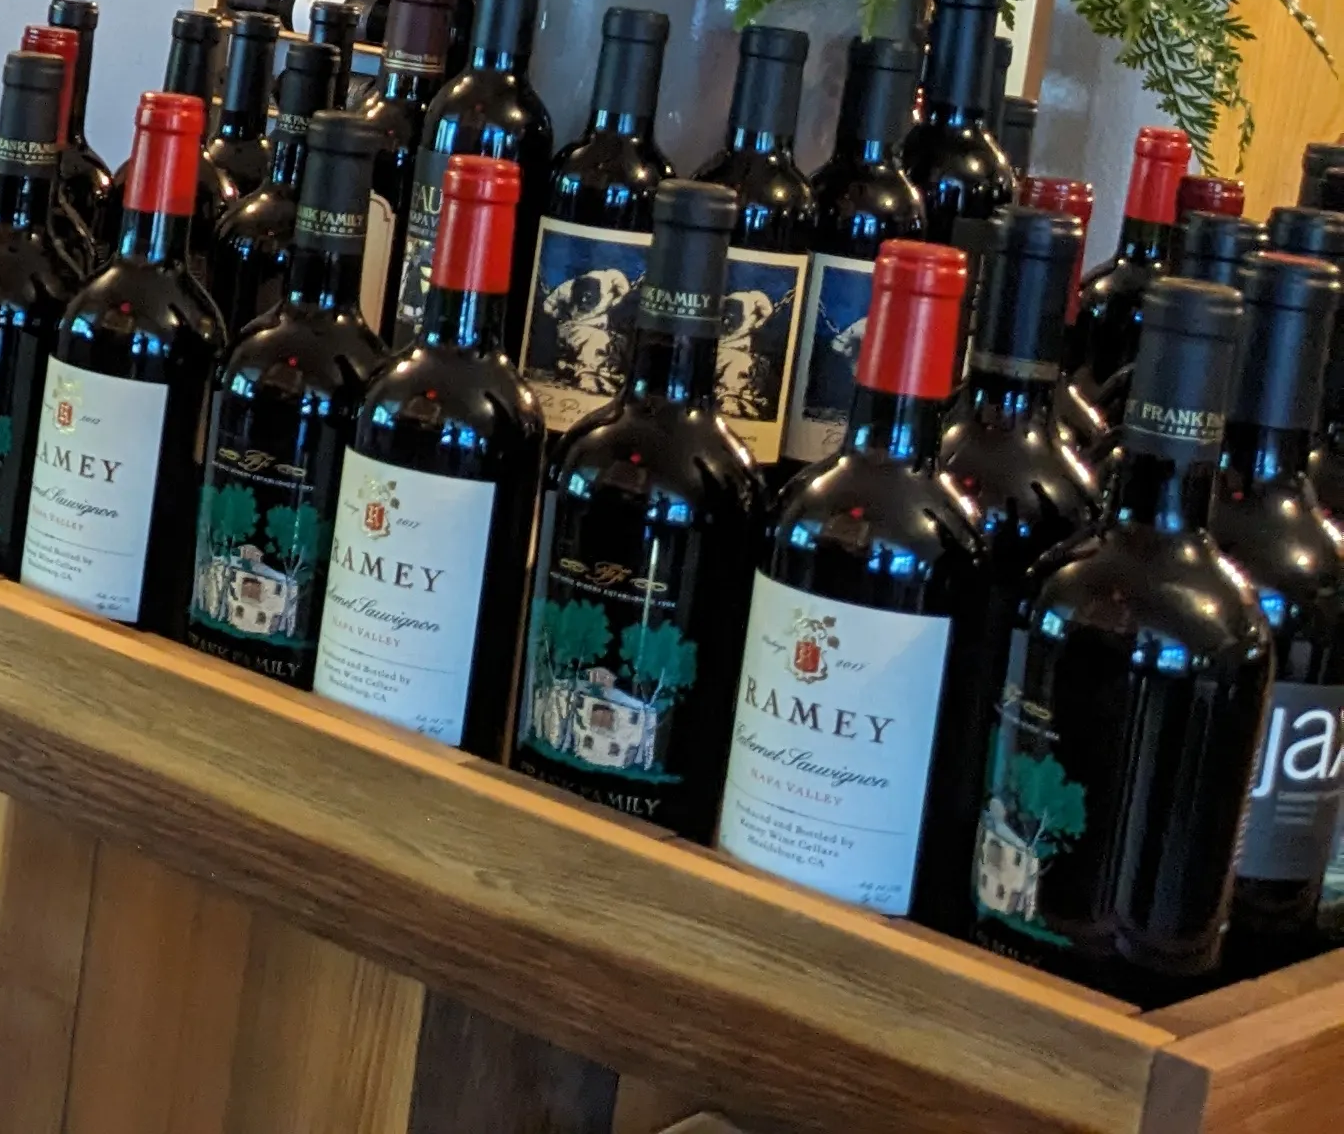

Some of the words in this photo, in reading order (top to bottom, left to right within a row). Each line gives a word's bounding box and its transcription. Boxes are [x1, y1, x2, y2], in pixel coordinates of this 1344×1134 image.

[655, 289, 711, 308] FAMILY
[1142, 402, 1205, 428] FRANK
[35, 441, 123, 483] AMEY
[331, 536, 445, 593] RAMEY
[354, 595, 441, 633] Sauvignon
[356, 626, 401, 648] VALLEY
[745, 674, 896, 745] RAMEY
[782, 747, 890, 789] Sauvignon
[750, 767, 783, 790] NAPA
[785, 779, 844, 807] VALLEY
[769, 828, 796, 846] Wine
[798, 836, 840, 858] Cellars
[773, 815, 793, 833] and
[795, 822, 838, 844] Bottled
[841, 836, 855, 850] by
[807, 854, 825, 868] CA
